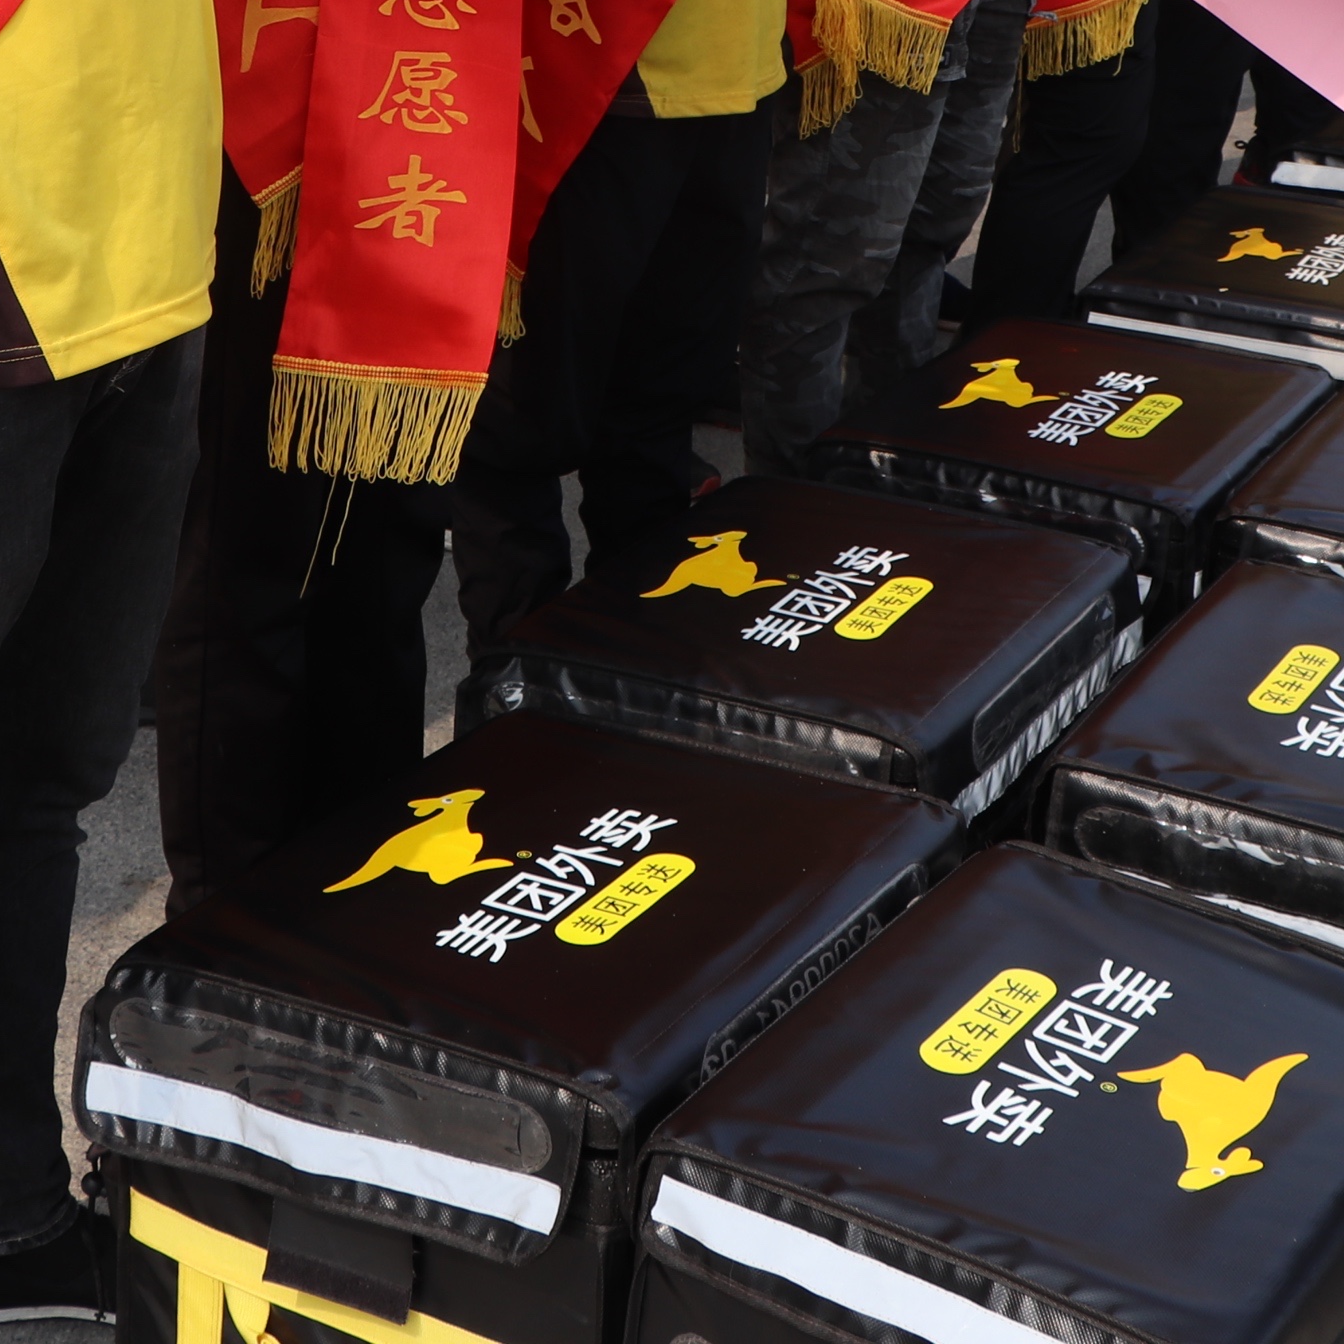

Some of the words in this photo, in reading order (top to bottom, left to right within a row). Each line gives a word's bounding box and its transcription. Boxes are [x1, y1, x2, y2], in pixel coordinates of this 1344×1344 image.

[1027, 371, 1160, 447] 美团外卖
[1115, 399, 1175, 435] 美团专送
[741, 545, 910, 652] 美团外卖
[846, 584, 924, 636] 美团专送
[1258, 652, 1330, 707] 美团专送
[436, 807, 678, 964] 美团外卖
[570, 862, 684, 938] 美团专送
[937, 982, 1044, 1066] 美团专送
[942, 958, 1173, 1150] 美团外卖
